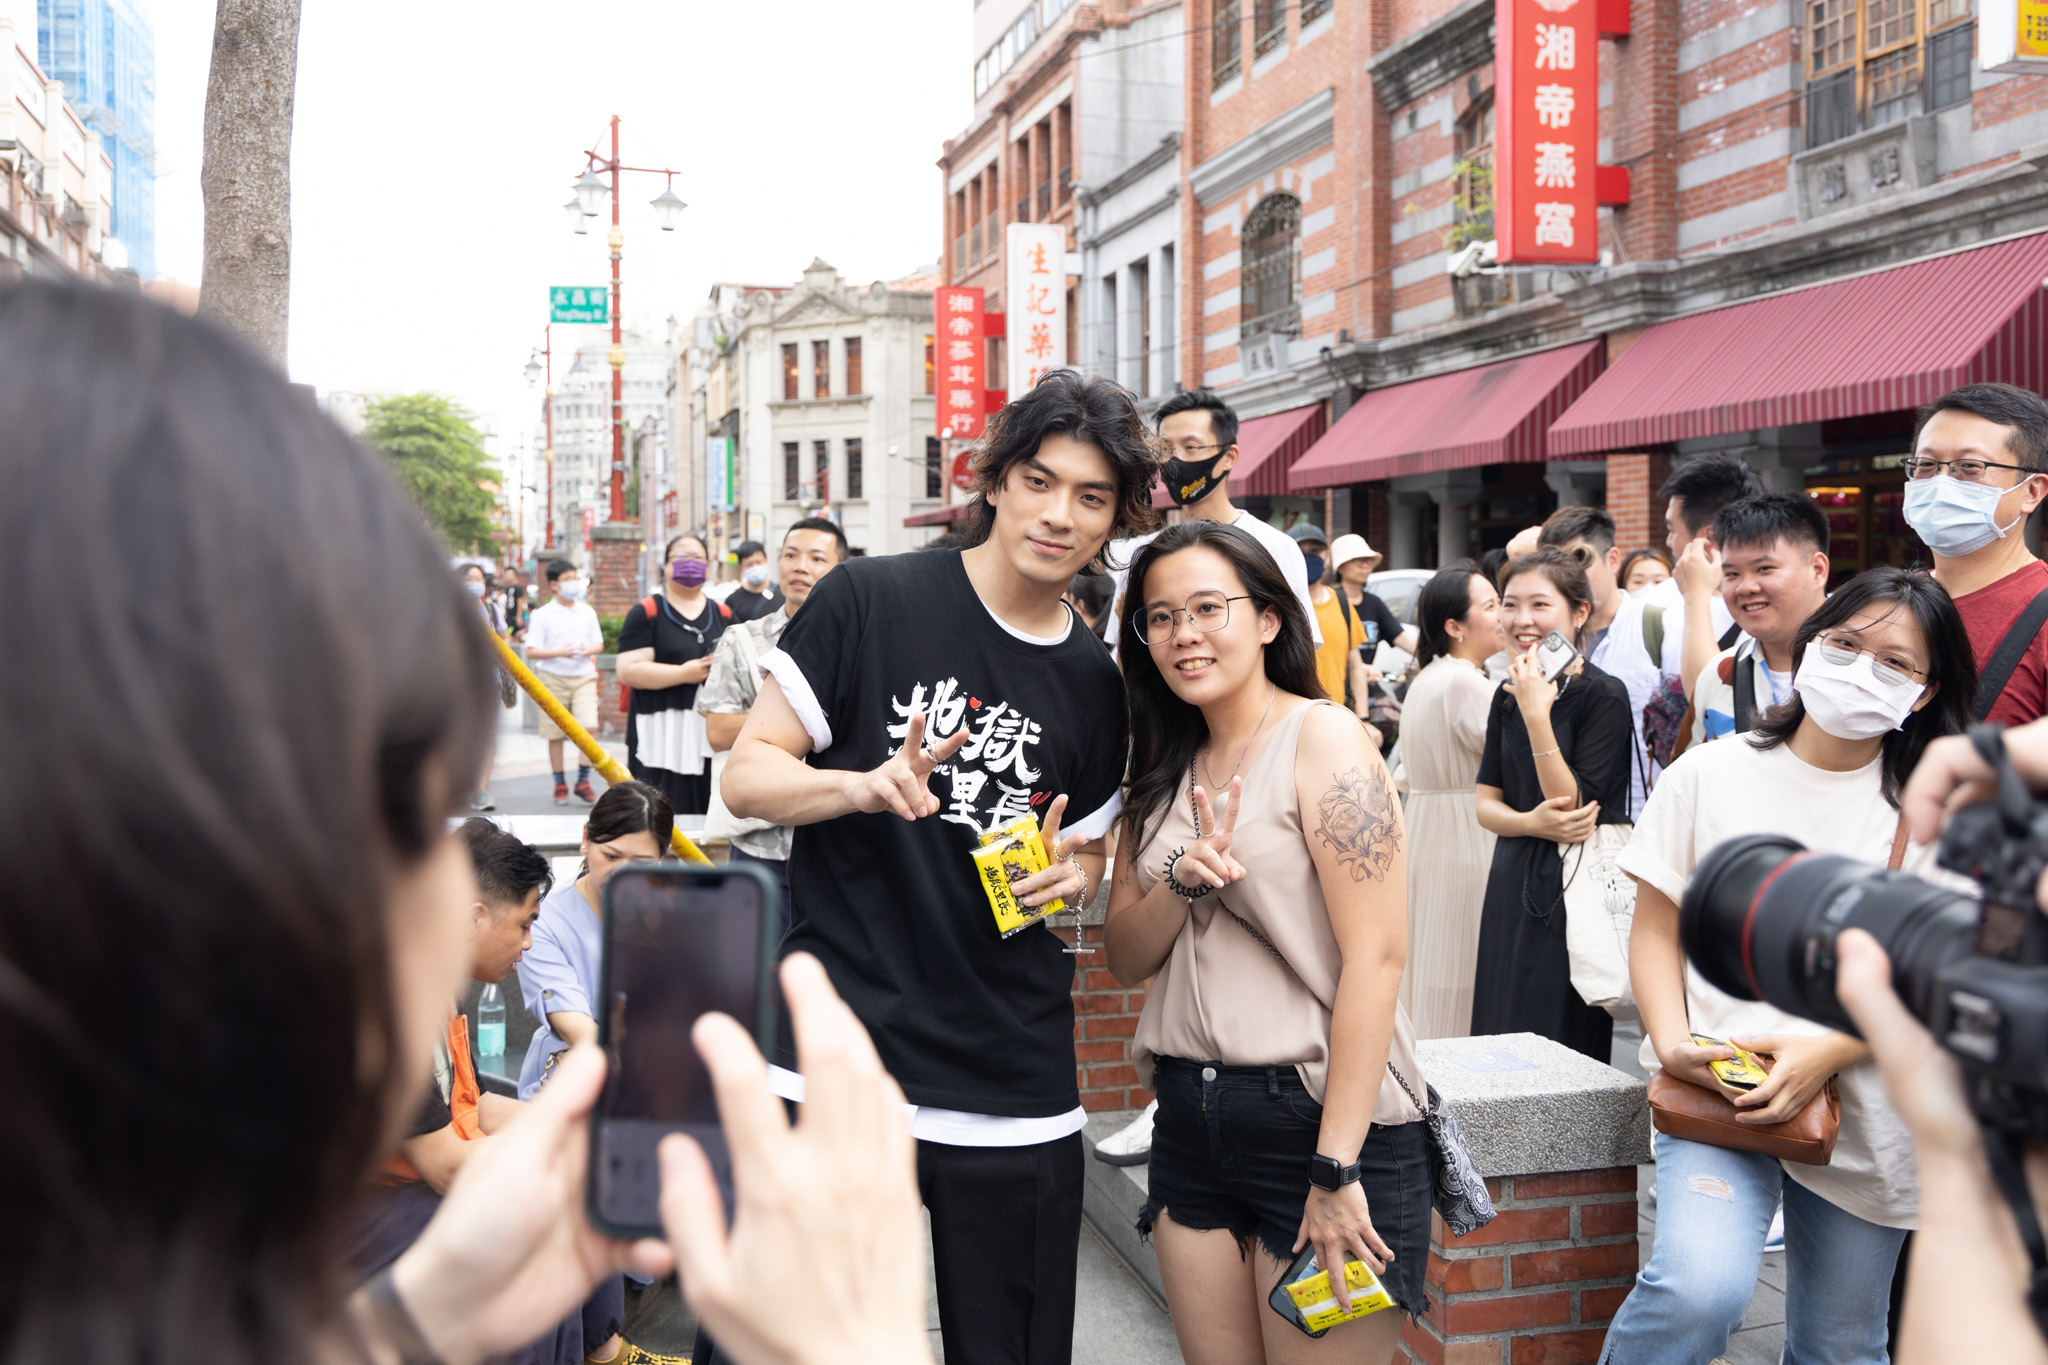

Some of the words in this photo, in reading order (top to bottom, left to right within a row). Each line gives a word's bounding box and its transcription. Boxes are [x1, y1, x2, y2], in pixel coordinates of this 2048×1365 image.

[1534, 22, 1576, 248] 湘帝燕窩
[553, 288, 604, 306] 永昌街
[886, 676, 1042, 785] 地獄
